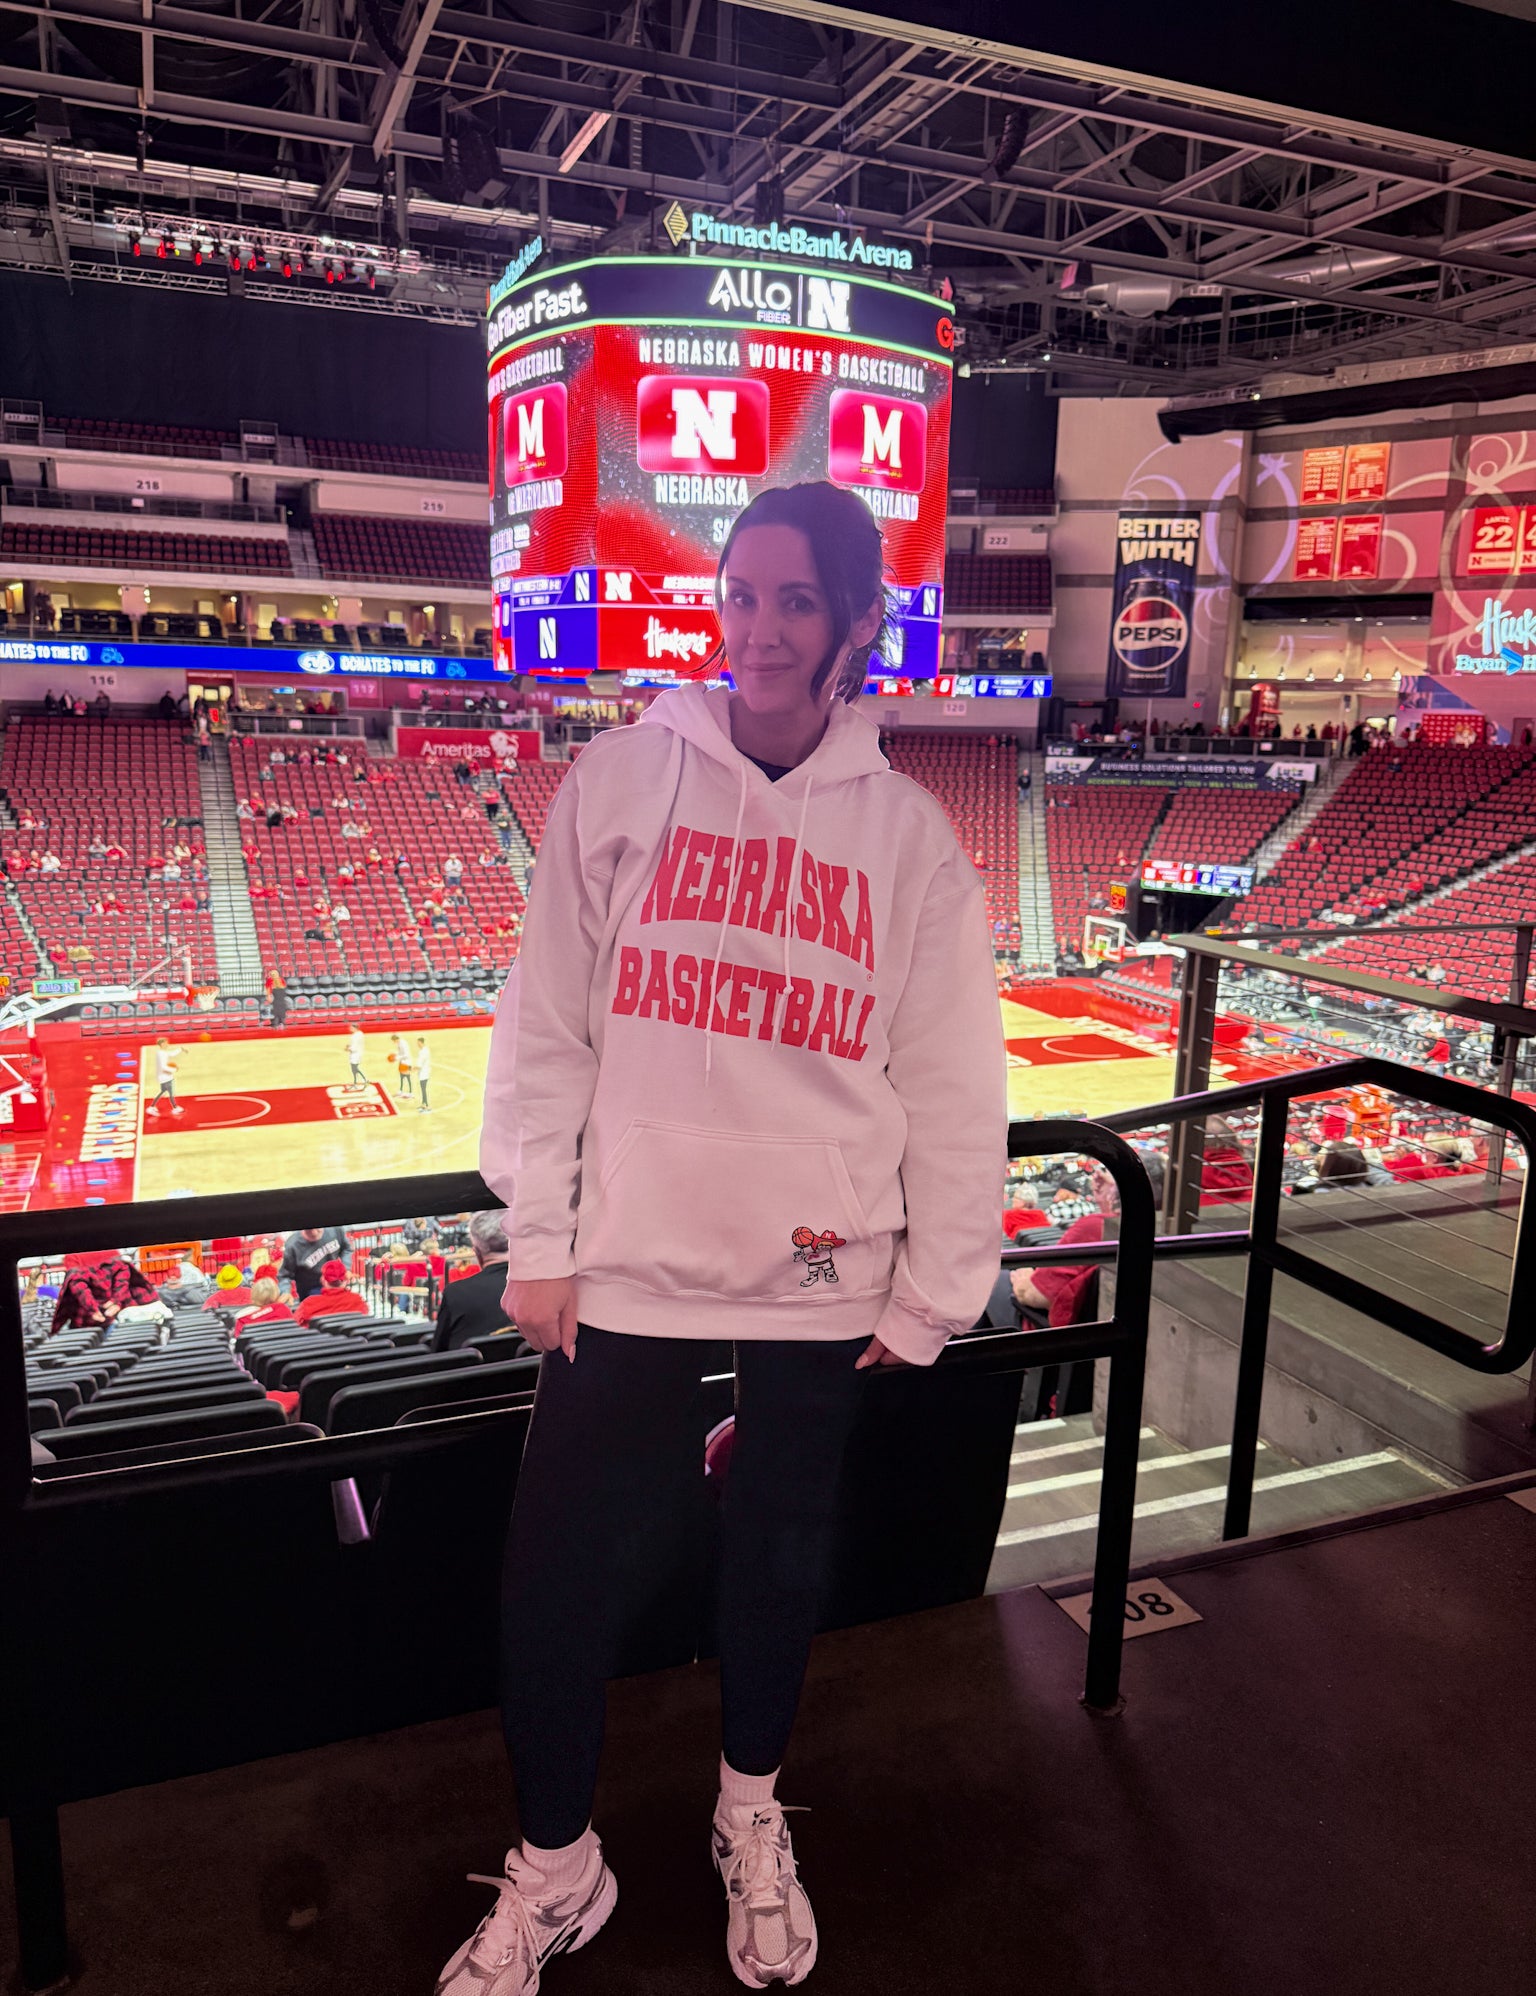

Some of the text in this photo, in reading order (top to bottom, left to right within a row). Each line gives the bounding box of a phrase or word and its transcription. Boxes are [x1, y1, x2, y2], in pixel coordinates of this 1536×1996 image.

[848, 236, 914, 271] Arena
[497, 304, 534, 342] Fiber
[534, 282, 588, 324] Fast.
[807, 276, 850, 332] N
[756, 310, 791, 325] FIBER
[506, 346, 564, 389] BASKETBALL
[638, 338, 926, 394] NEBRASKA WOMEN'S BASKETBALL
[516, 398, 546, 463] M
[671, 388, 737, 460] N
[861, 403, 903, 469] M
[136, 479, 160, 491] 218
[653, 474, 750, 506] NEBRASKA
[422, 501, 444, 512] 219
[989, 537, 1009, 545] 222
[1117, 518, 1200, 539] BETTER
[1475, 525, 1514, 550] 22
[1120, 541, 1195, 568] WITH
[1471, 556, 1483, 566] N
[1522, 554, 1533, 564] N
[575, 571, 590, 602] N
[604, 571, 632, 602] N
[923, 588, 937, 616] N
[538, 617, 557, 660] N
[1119, 627, 1182, 642] PEPSI
[36, 645, 50, 659] TO
[340, 655, 391, 673] DONATES
[392, 658, 404, 672] TO
[1455, 654, 1508, 675] Bryan
[91, 676, 114, 685] 116
[353, 685, 376, 695] 117
[1032, 679, 1046, 696] N
[946, 704, 965, 712] 120
[421, 741, 491, 757] Ameritas
[1100, 762, 1255, 775] BUSINESS SOLUTIONS TAILORED TO YOU
[639, 825, 875, 974] NEBRASKA
[611, 946, 876, 1062] BASKETBALL
[79, 1082, 139, 1162] HUSKERS
